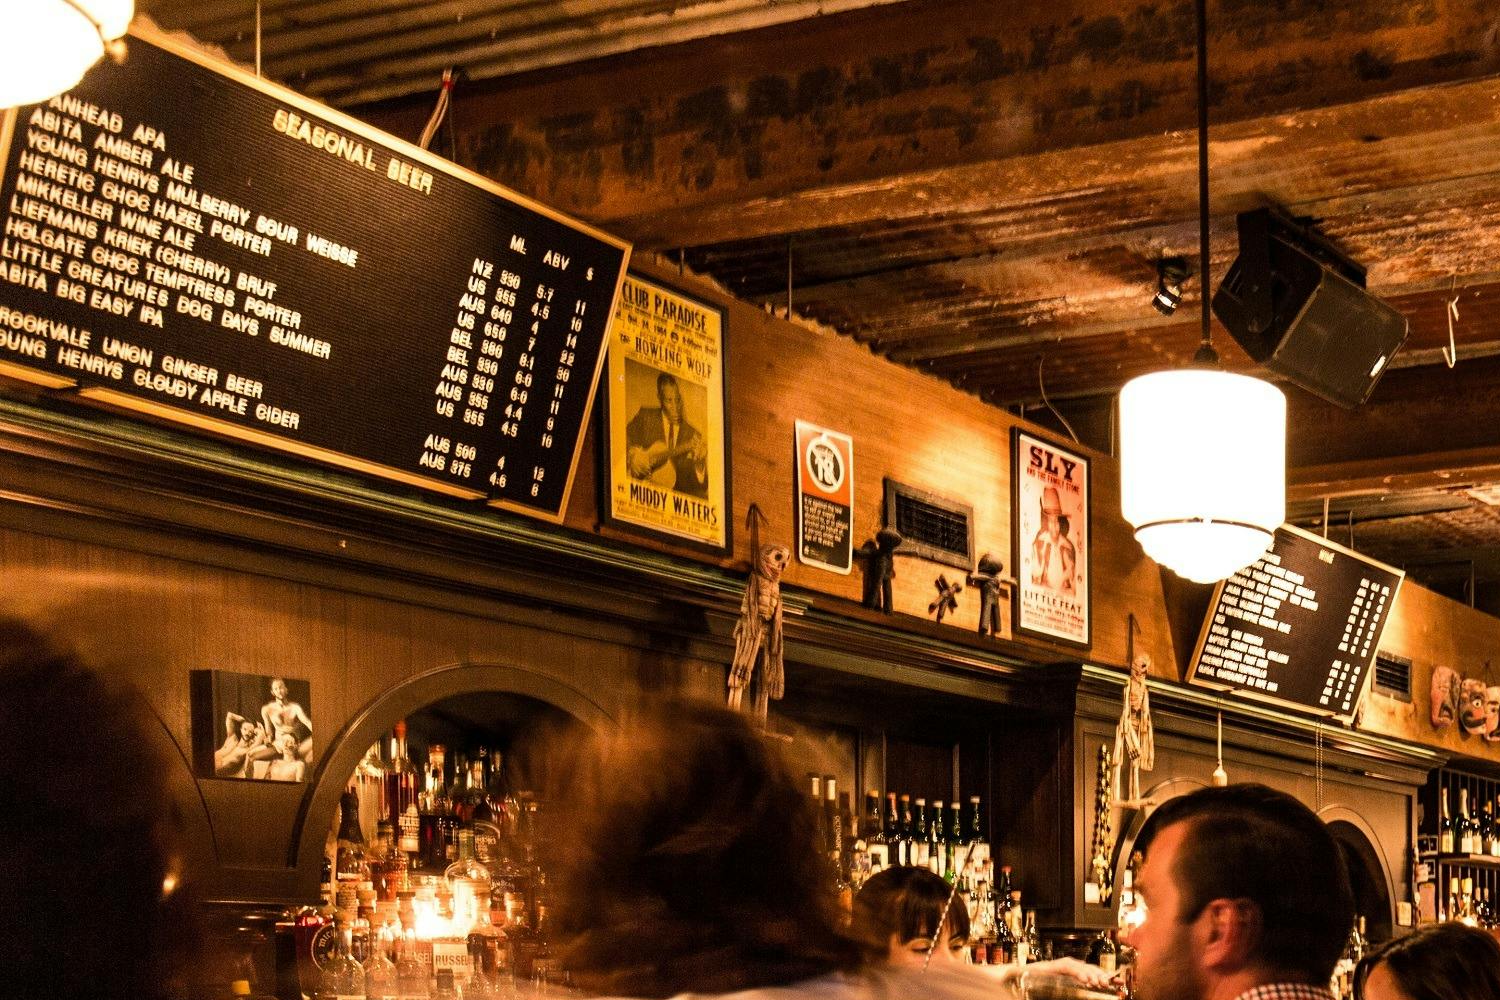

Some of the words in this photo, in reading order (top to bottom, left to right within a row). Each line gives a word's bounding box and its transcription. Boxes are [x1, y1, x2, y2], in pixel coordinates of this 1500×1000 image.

[50, 94, 124, 134] ANHEAD
[132, 121, 166, 152] APA
[29, 107, 82, 143] ABITA
[94, 132, 153, 169] AMBER
[160, 157, 195, 185] ALE
[273, 109, 377, 172] SEASONAL
[387, 157, 433, 195] BEER
[16, 171, 114, 223] MIKKELLER
[120, 208, 162, 240] WINE
[163, 225, 196, 251] ALE
[19, 149, 96, 193] HERETIC
[101, 181, 151, 212] CHOC
[153, 198, 204, 234] HAZEL
[210, 219, 272, 257] PORTER
[27, 127, 88, 168] YOUNG
[94, 154, 160, 194] HENRYS
[166, 180, 250, 227] MULBERRY
[255, 214, 299, 246] SOUR
[306, 231, 358, 268] WEISSE
[10, 193, 98, 240] LIEFMANS
[104, 226, 153, 259] KRIEK
[156, 245, 231, 285] (CHERRY)
[236, 271, 278, 300] BRUT
[472, 257, 494, 280] NZ
[509, 234, 527, 255] ML
[543, 249, 571, 271] ABV
[0, 260, 48, 293] ABITA
[56, 278, 87, 304] BIG
[90, 289, 135, 318] EASY
[139, 304, 164, 329] IPA
[5, 215, 87, 259] HOLGATE
[91, 246, 140, 275] CHOC
[145, 262, 236, 308] TEMPTRESS
[244, 296, 302, 330] PORTER
[467, 275, 487, 296] US
[1, 237, 64, 274] LITTLE
[68, 260, 170, 307] CREATURES
[176, 295, 213, 322] DOG
[221, 310, 260, 337] DAYS
[269, 325, 332, 360] SUMMER
[458, 292, 486, 315] AUS
[531, 320, 539, 335] 4
[622, 280, 649, 309] CLUB
[654, 294, 708, 333] PARADISE
[0, 305, 92, 350] ROOKVALE
[102, 336, 153, 368] UNION
[162, 355, 219, 387] GINGER
[225, 373, 264, 400] BEER
[450, 327, 473, 350] BEL
[457, 310, 476, 331] US
[528, 336, 537, 352] 7
[440, 363, 469, 385] AUS
[446, 345, 469, 367] BEL
[635, 336, 682, 368] HOWLING
[687, 356, 713, 380] WOLF
[0, 329, 47, 359] OUNG
[57, 346, 124, 380] HENRYS
[133, 368, 198, 401] CLOUDY
[199, 388, 249, 416] APPLE
[255, 402, 301, 431] CIDER
[435, 380, 463, 402] AUS
[436, 398, 455, 418] US
[419, 450, 446, 471] AUS
[423, 433, 451, 454] AUS
[497, 455, 506, 471] 4
[1030, 445, 1077, 481] SLY
[630, 482, 668, 512] MUDDY
[673, 495, 718, 526] WATERS
[1025, 589, 1057, 606] LITTLE
[1060, 600, 1082, 614] FEAT
